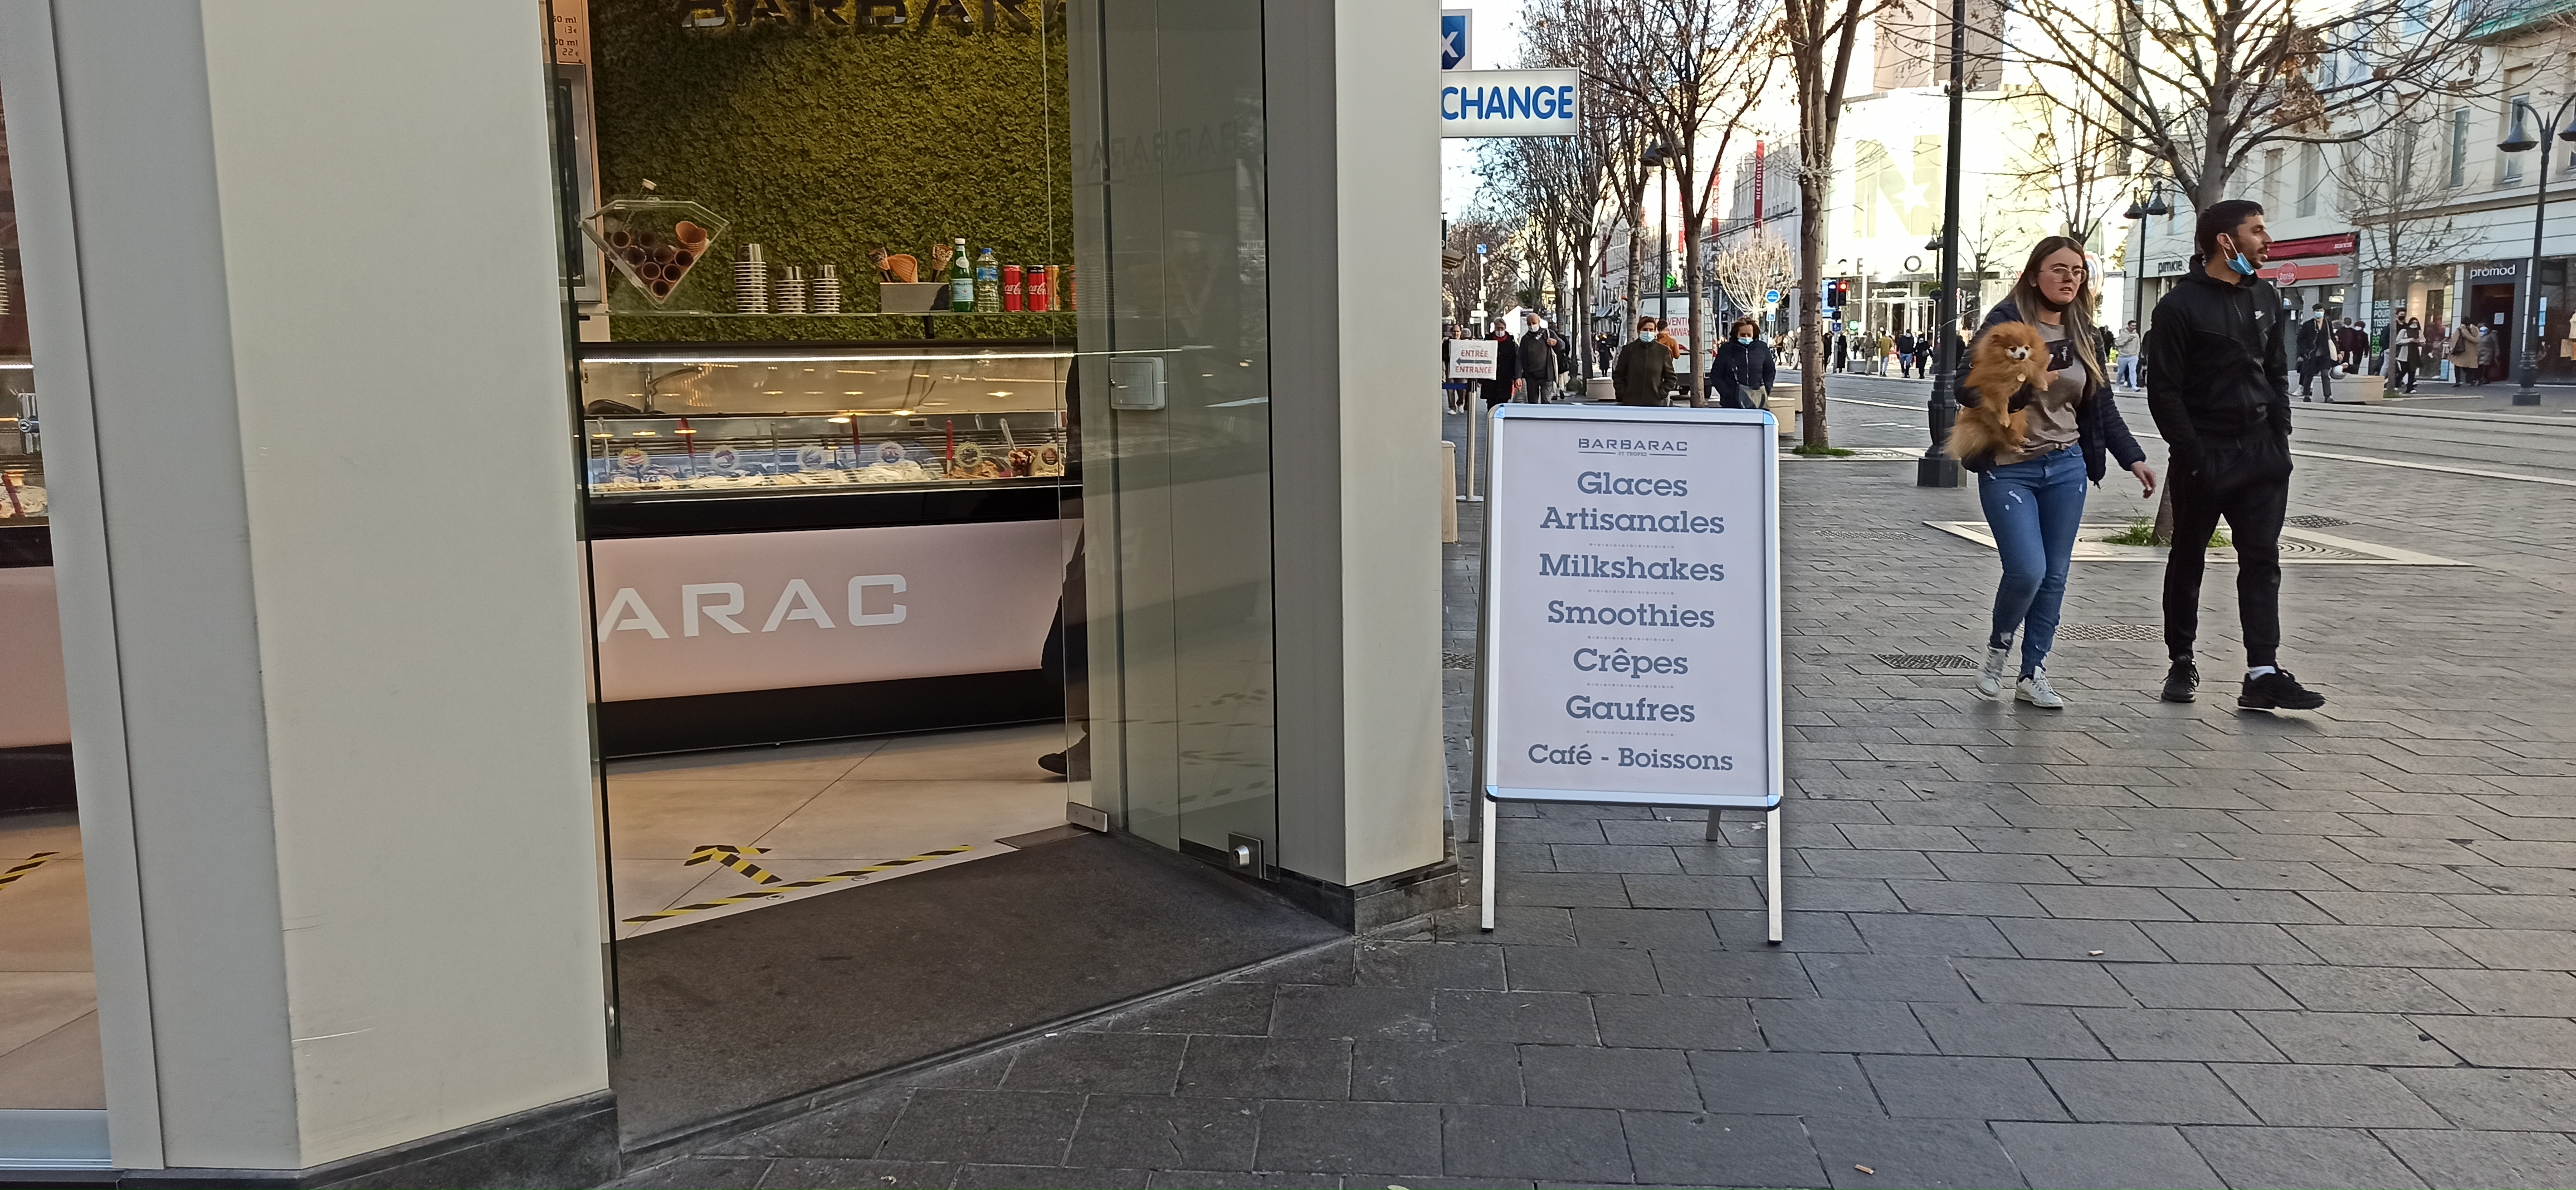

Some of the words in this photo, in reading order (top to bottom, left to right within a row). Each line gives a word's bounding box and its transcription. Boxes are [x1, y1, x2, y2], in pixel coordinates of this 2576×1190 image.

[1442, 86, 1573, 120] CHANGE
[2470, 264, 2516, 280] promod
[2374, 299, 2405, 309] ENSELE
[1461, 349, 1488, 357] ENTRÉE
[1578, 438, 1687, 452] BARBARAC
[1578, 471, 1687, 496] Glaces
[1540, 506, 1724, 534] Artisanales
[1539, 554, 1724, 581] Milkshakes
[1548, 601, 1715, 628] Smoothies
[1574, 647, 1688, 679] Crêpes
[1566, 695, 1695, 723] Gaufres
[1528, 743, 1592, 765] Café
[1618, 748, 1733, 771] Boissons
